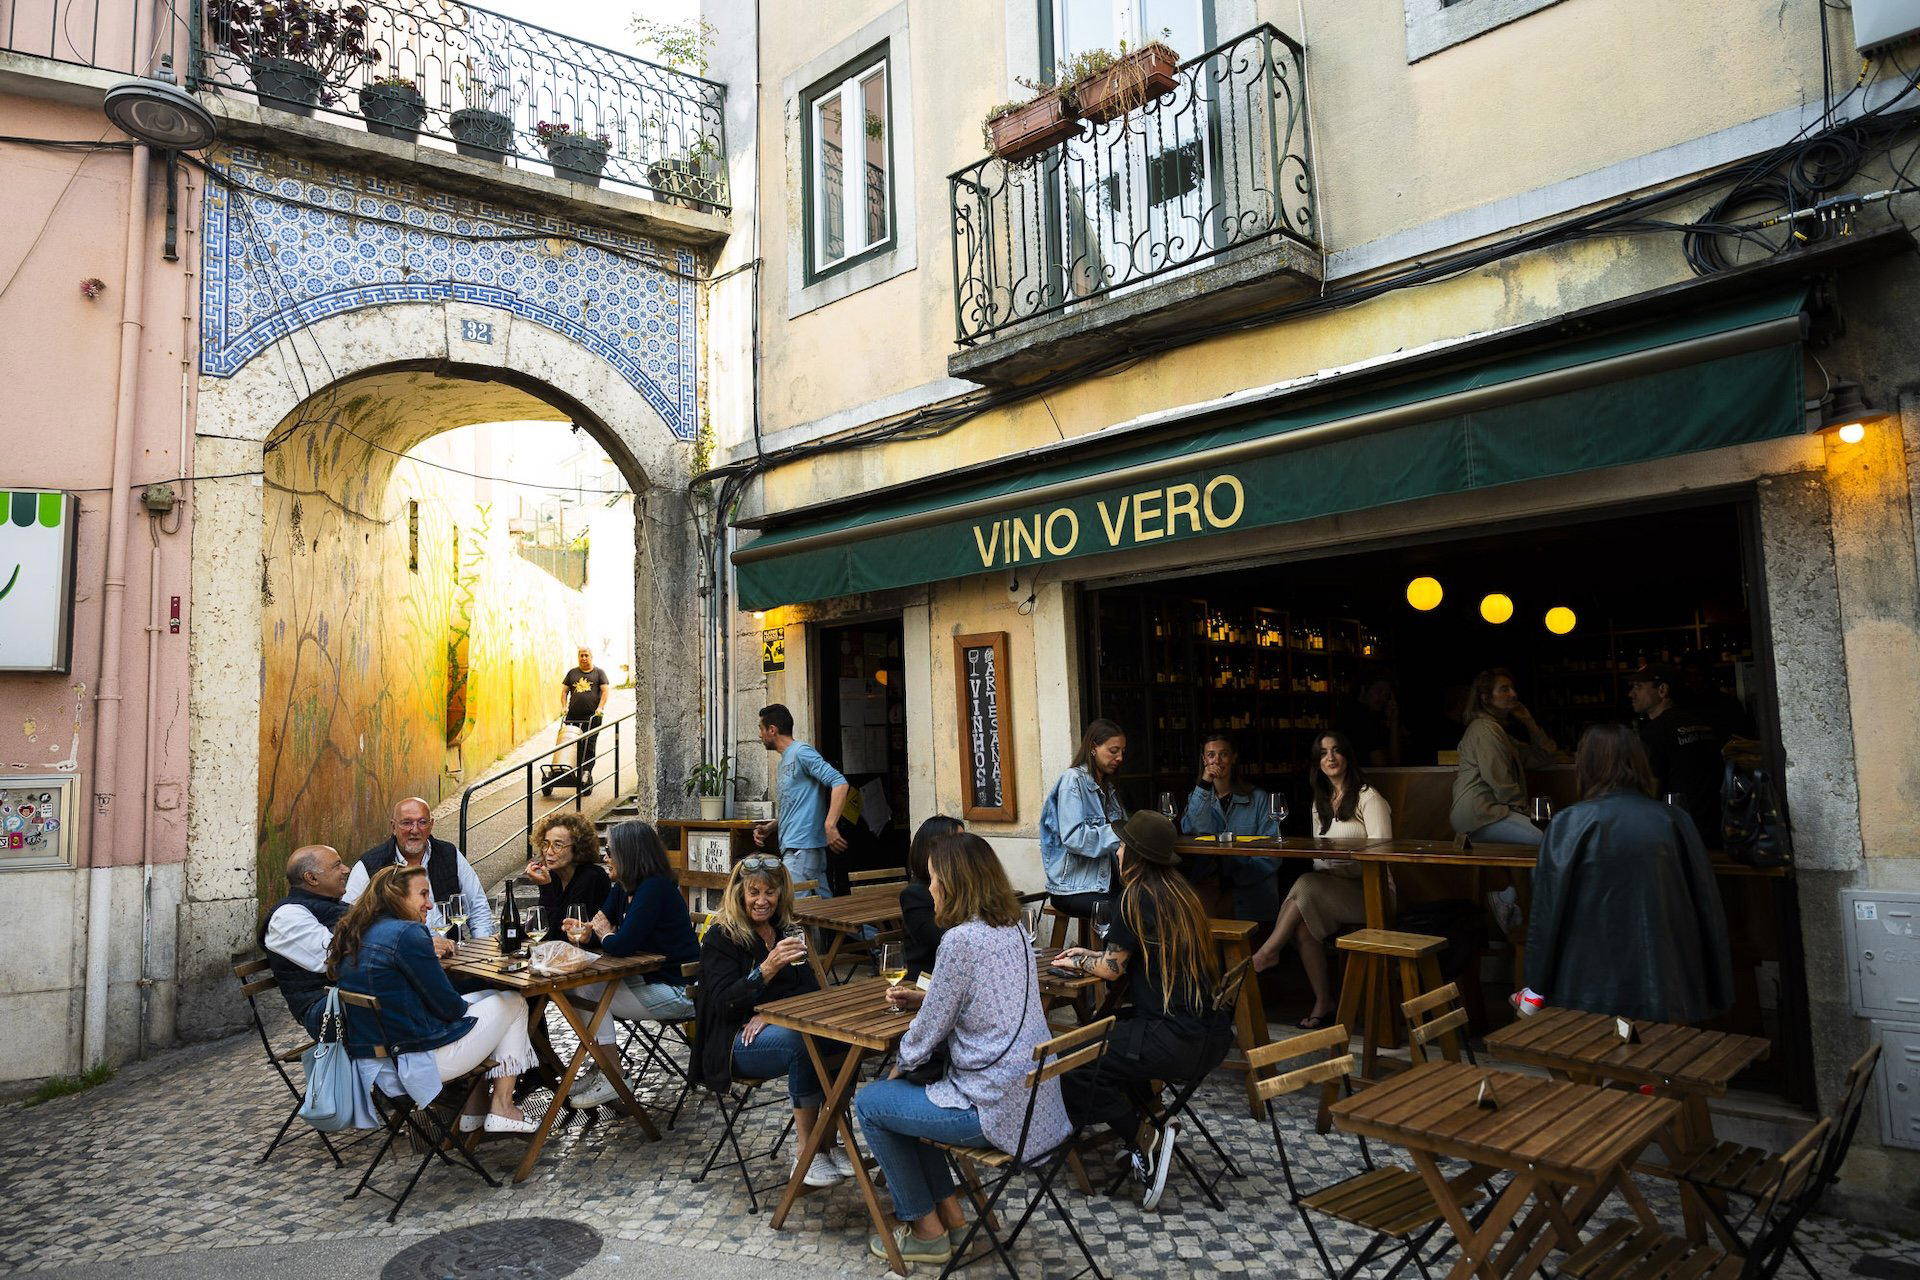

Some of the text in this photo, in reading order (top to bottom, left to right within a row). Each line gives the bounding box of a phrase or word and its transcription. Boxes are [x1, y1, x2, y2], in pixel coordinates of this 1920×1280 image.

[467, 321, 488, 341] 32
[973, 474, 1245, 568] VINO VERO
[969, 679, 987, 788] VINHOS
